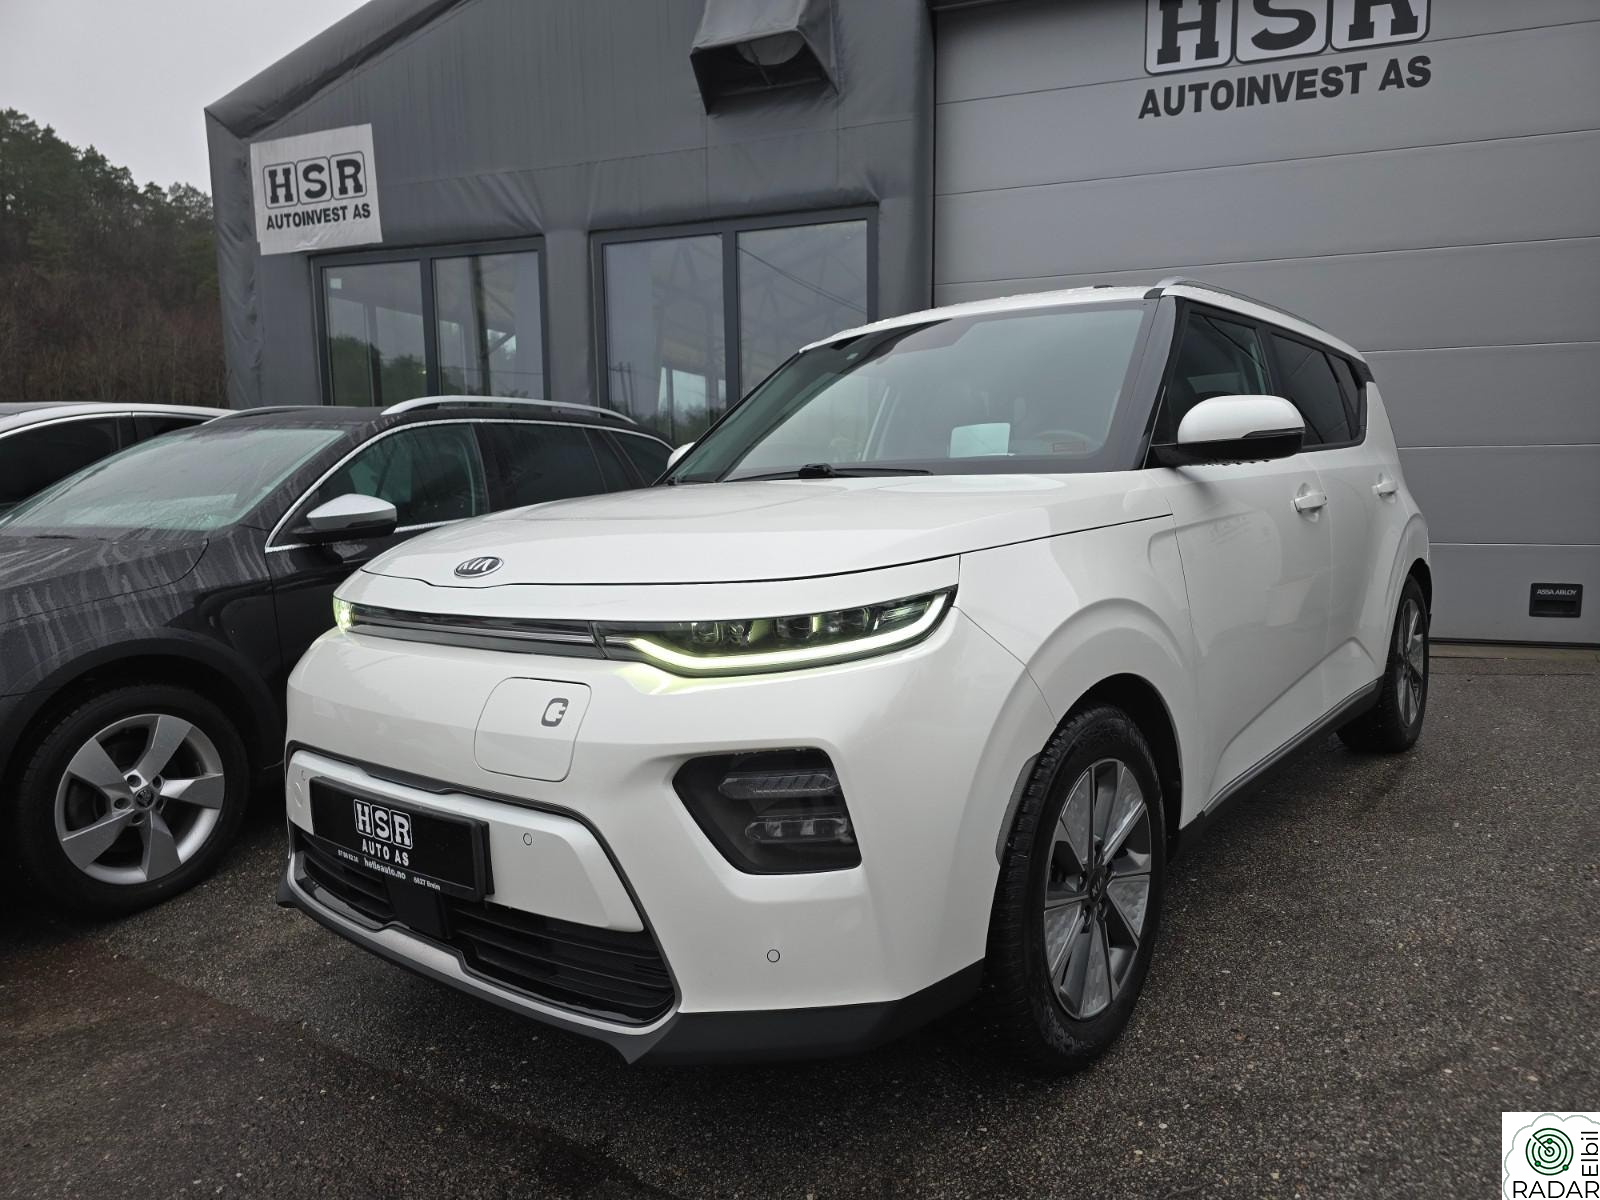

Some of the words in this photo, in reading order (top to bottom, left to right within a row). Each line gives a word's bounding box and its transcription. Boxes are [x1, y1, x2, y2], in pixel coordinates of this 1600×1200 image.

[1138, 63, 1368, 119] AUTOINVEST
[1378, 55, 1432, 91] AS
[267, 158, 364, 204] HSR
[266, 205, 348, 231] AUTOINVEST
[352, 203, 371, 220] AS
[456, 558, 497, 572] KIA
[355, 801, 412, 847] HSR
[362, 838, 390, 861] AUTO
[394, 850, 409, 867] AS
